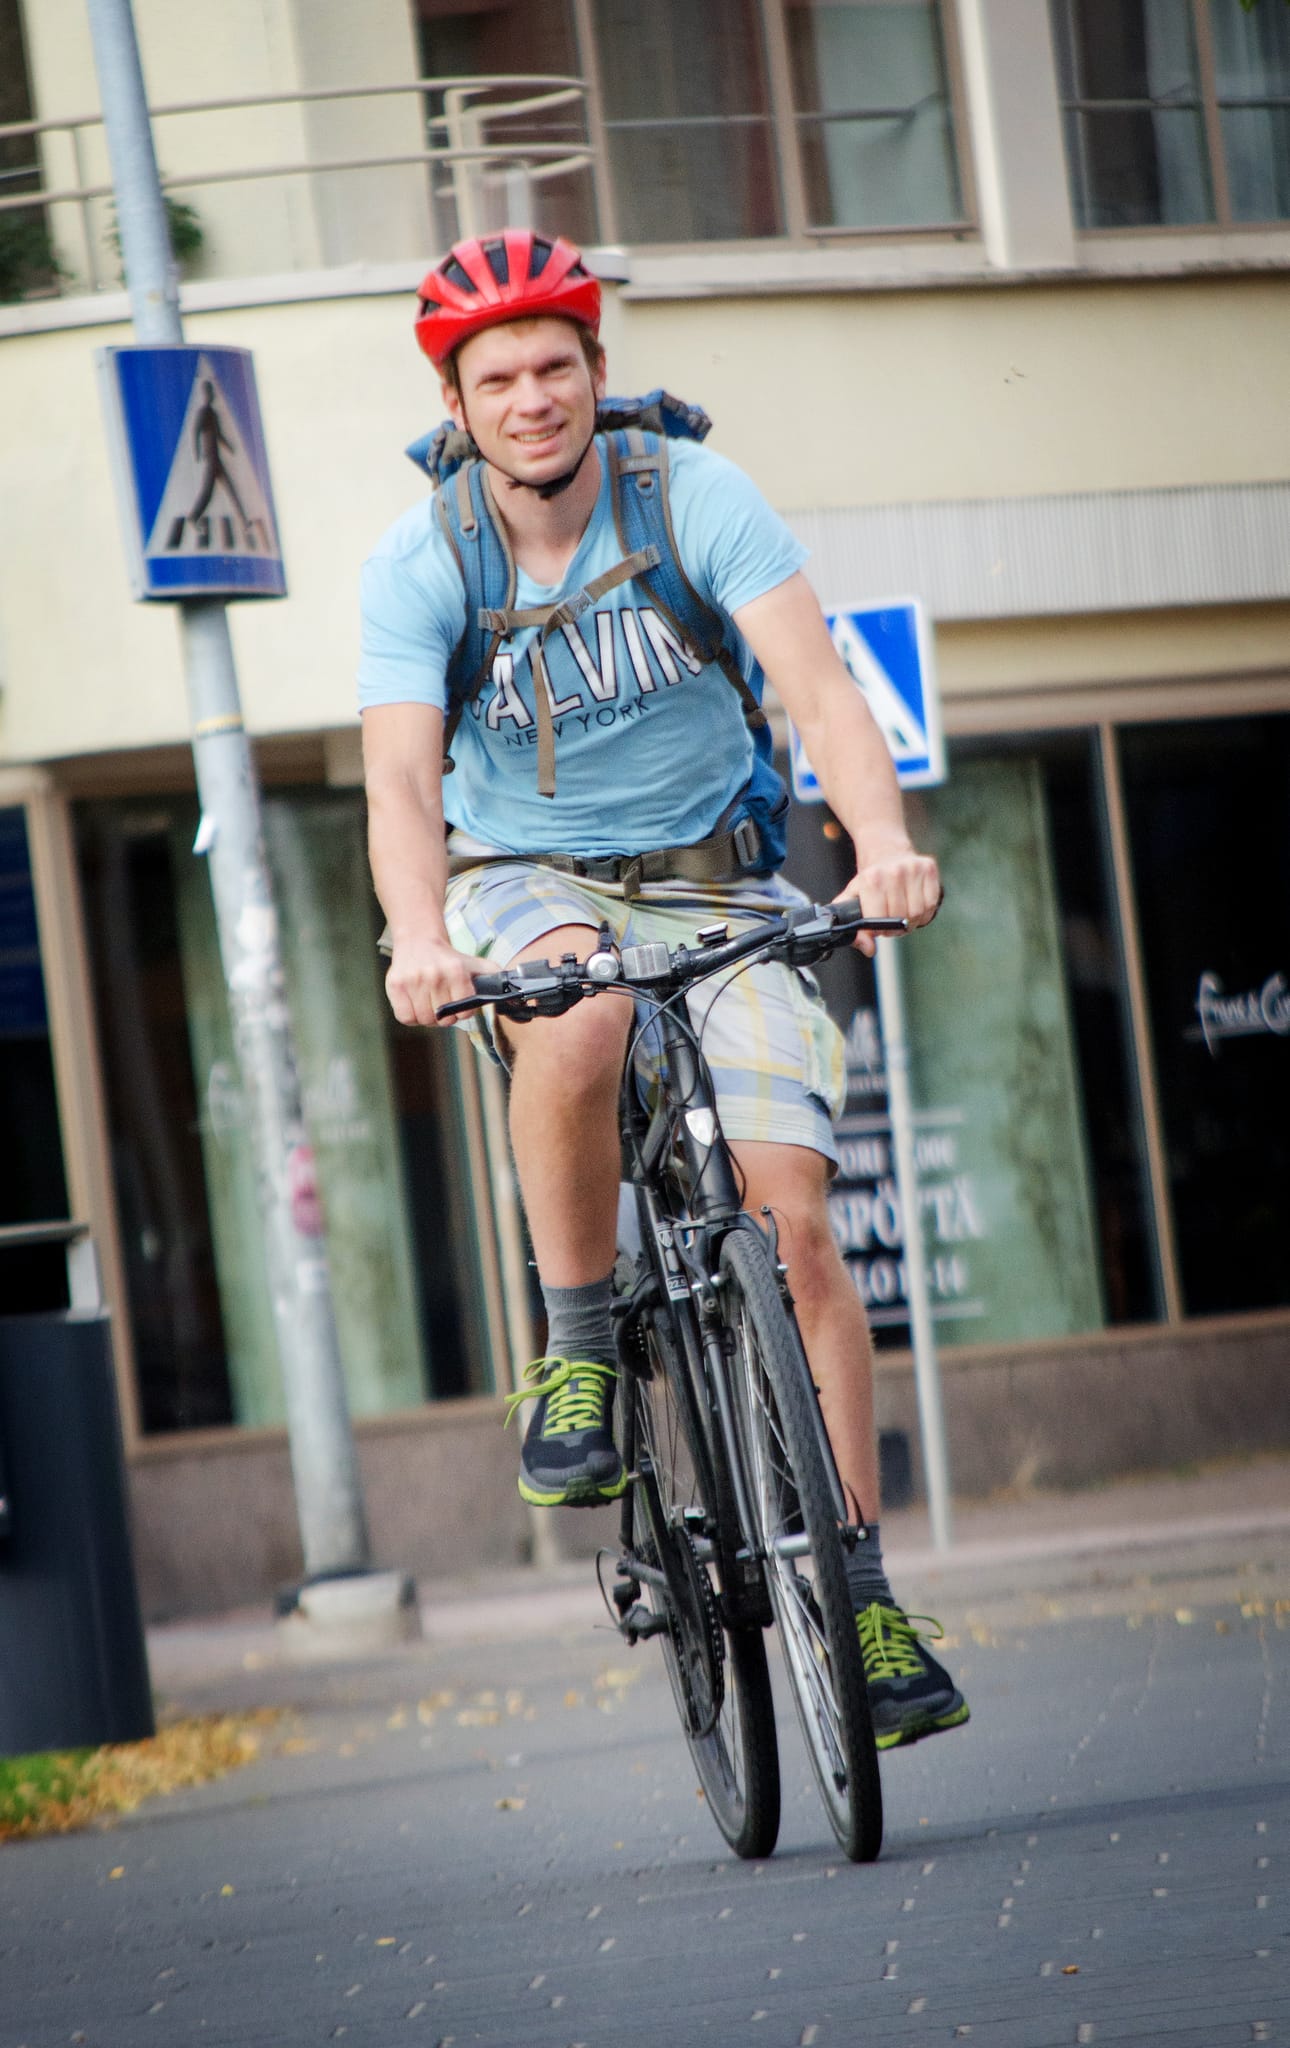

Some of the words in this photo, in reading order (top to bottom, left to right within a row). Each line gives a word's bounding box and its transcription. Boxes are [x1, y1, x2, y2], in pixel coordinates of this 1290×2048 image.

[471, 606, 702, 731] ALVIN
[576, 695, 650, 734] YORK
[831, 1173, 983, 1250] SPÖTÄ
